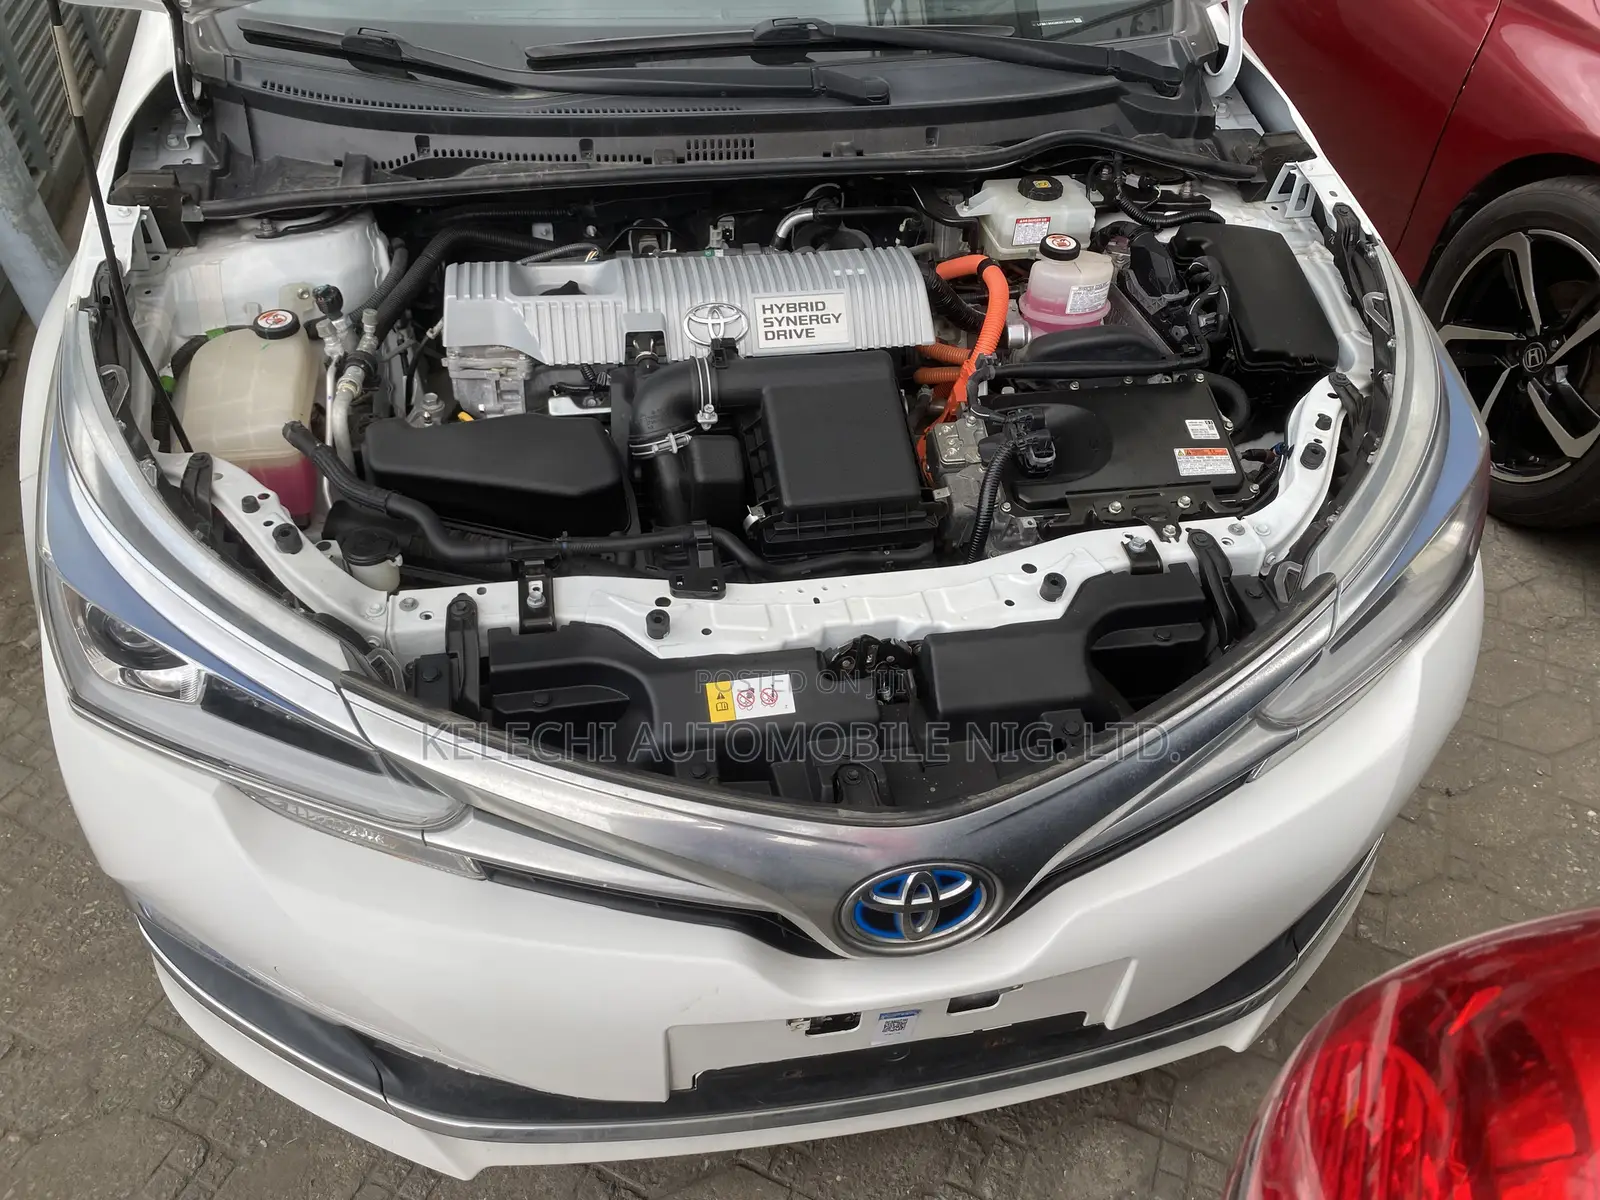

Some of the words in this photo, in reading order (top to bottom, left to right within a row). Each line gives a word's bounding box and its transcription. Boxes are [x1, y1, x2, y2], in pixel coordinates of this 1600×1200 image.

[763, 301, 826, 314] HYBRID
[763, 313, 842, 328] SYNERGY
[764, 328, 816, 341] DRIVE
